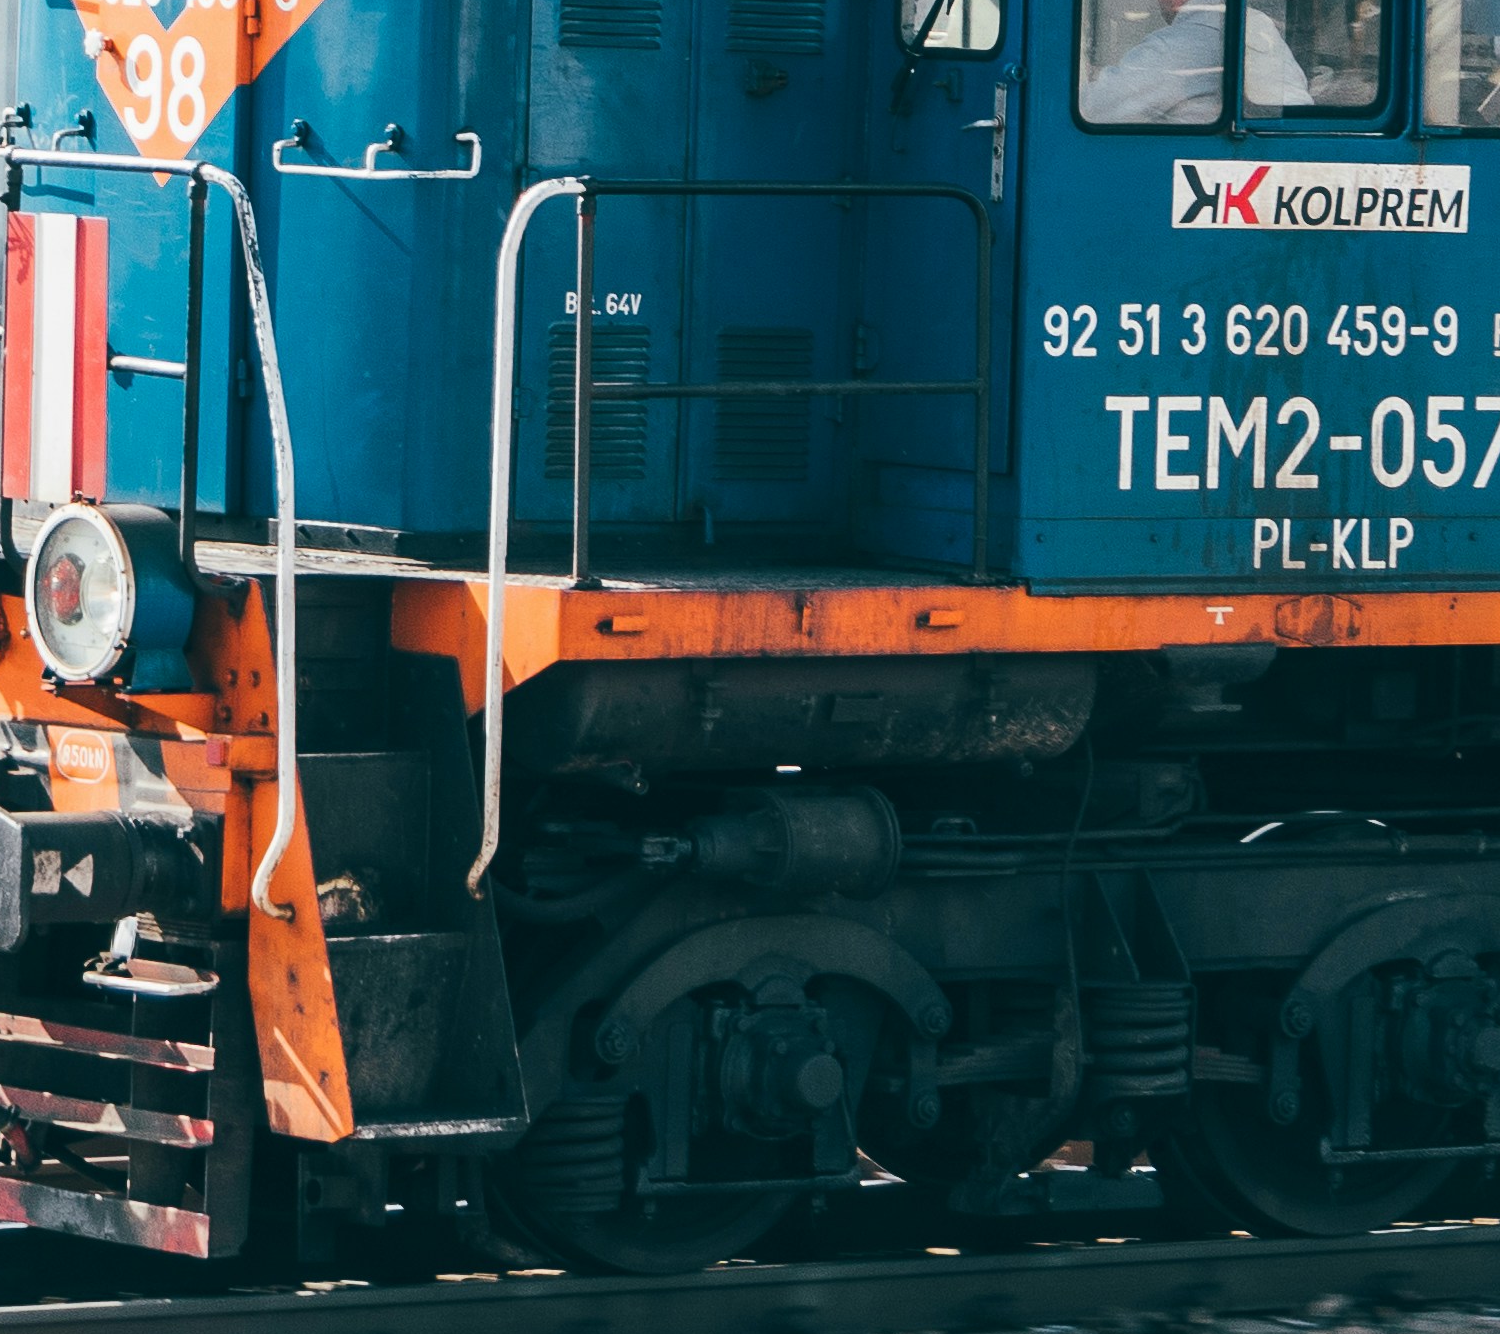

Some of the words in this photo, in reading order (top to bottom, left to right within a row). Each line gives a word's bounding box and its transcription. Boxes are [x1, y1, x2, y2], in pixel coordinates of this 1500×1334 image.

[123, 33, 205, 143] 98
[1274, 185, 1465, 228] KOLPREM
[606, 293, 642, 315] 64V
[1043, 304, 1098, 357] 92
[1118, 303, 1160, 356] 51
[1181, 303, 1207, 355] 3
[1226, 303, 1309, 356] 620
[1326, 304, 1458, 357] 459-9
[1253, 517, 1414, 570] PL-KLP
[62, 744, 104, 769] 850kN
